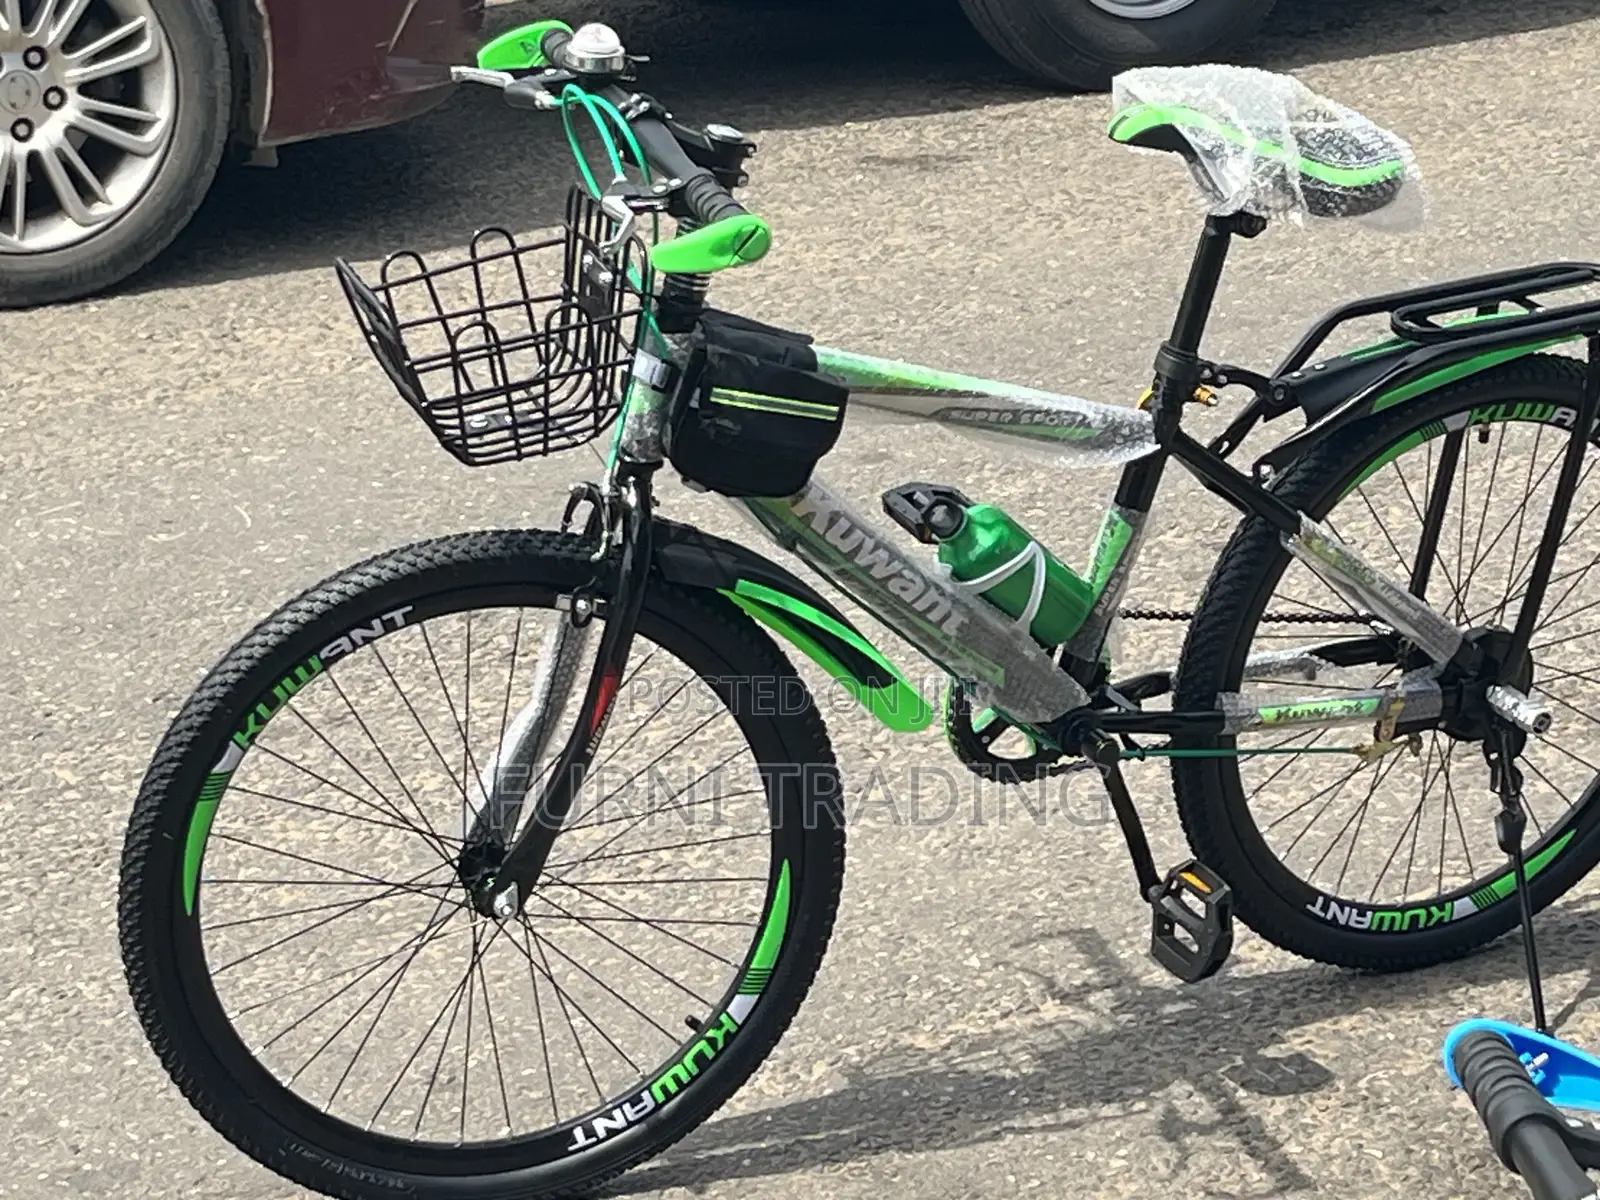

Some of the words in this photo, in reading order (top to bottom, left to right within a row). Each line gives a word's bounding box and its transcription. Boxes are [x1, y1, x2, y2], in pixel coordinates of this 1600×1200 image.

[950, 409, 1014, 424] SUPER
[791, 485, 967, 633] Kuwant
[233, 605, 413, 749] KUWANT
[1306, 896, 1452, 931] KUWANT
[568, 1012, 738, 1151] KUWANT
